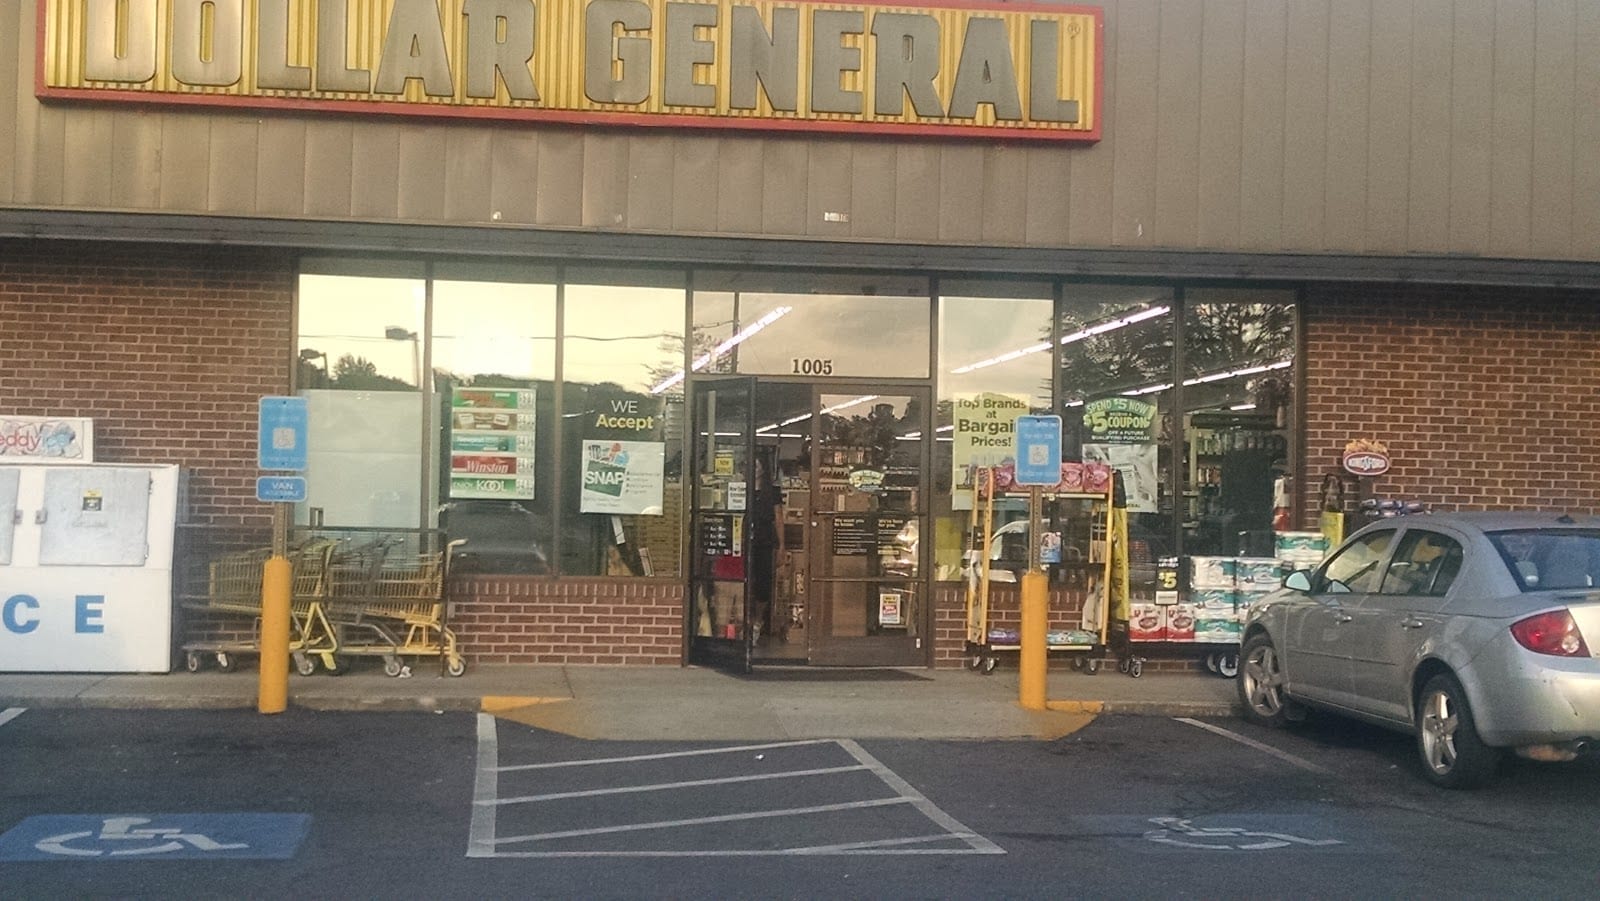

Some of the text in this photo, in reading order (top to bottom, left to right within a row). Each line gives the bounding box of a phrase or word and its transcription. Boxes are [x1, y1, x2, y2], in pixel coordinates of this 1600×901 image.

[84, 0, 1080, 123] DOLLAR GENERAL
[792, 358, 833, 376] 1005
[611, 400, 638, 414] WE
[958, 398, 1027, 410] Top Brands
[1086, 399, 1112, 414] SPEND
[1113, 398, 1128, 410] $5
[595, 414, 654, 431] Accept
[986, 410, 997, 419] at
[1083, 411, 1108, 433] $5
[958, 419, 1016, 435] Bargai
[0, 430, 42, 452] eddy
[971, 436, 1012, 447] Prices!
[465, 460, 509, 474] Winston
[271, 481, 294, 490] VAN
[476, 480, 507, 492] KOOL
[585, 471, 625, 485] SNAP
[1158, 571, 1178, 589] $5
[2, 593, 105, 635] CE
